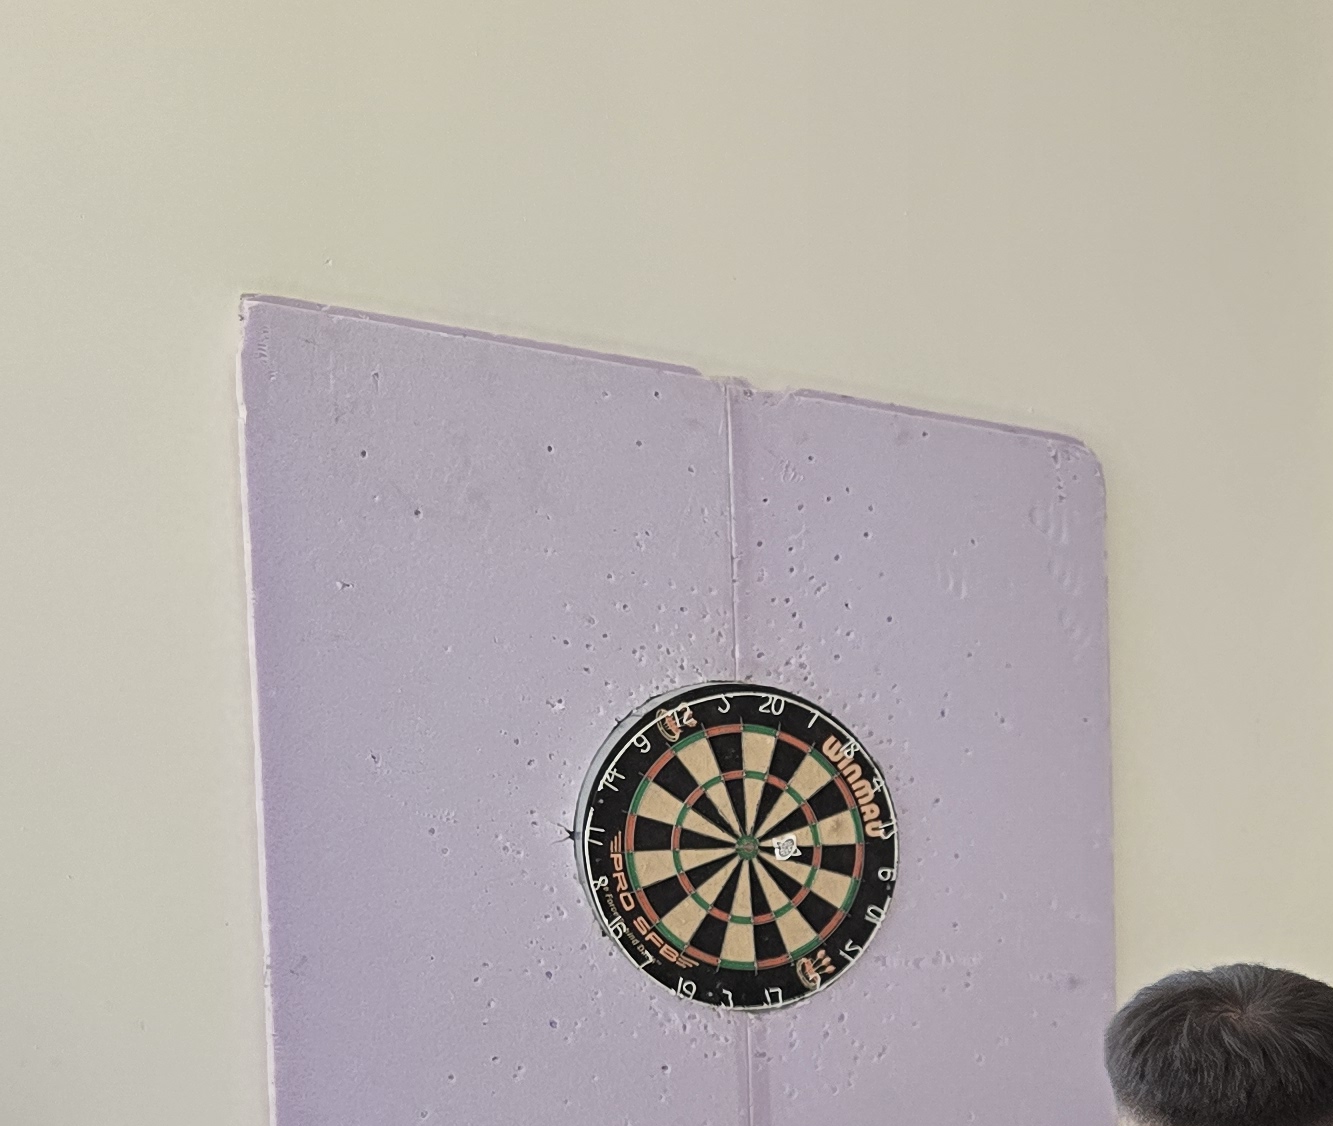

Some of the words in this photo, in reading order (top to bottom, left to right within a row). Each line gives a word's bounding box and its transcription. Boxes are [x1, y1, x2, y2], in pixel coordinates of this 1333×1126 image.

[759, 695, 785, 715] 20
[633, 734, 651, 754] 9
[840, 737, 860, 759] 18
[602, 767, 626, 792] 14
[823, 735, 882, 838] WINMAU
[592, 875, 608, 891] 8
[610, 853, 637, 912] PRO
[633, 916, 680, 963] SFB
[676, 977, 697, 1000] 19
[764, 987, 782, 1007] 17
